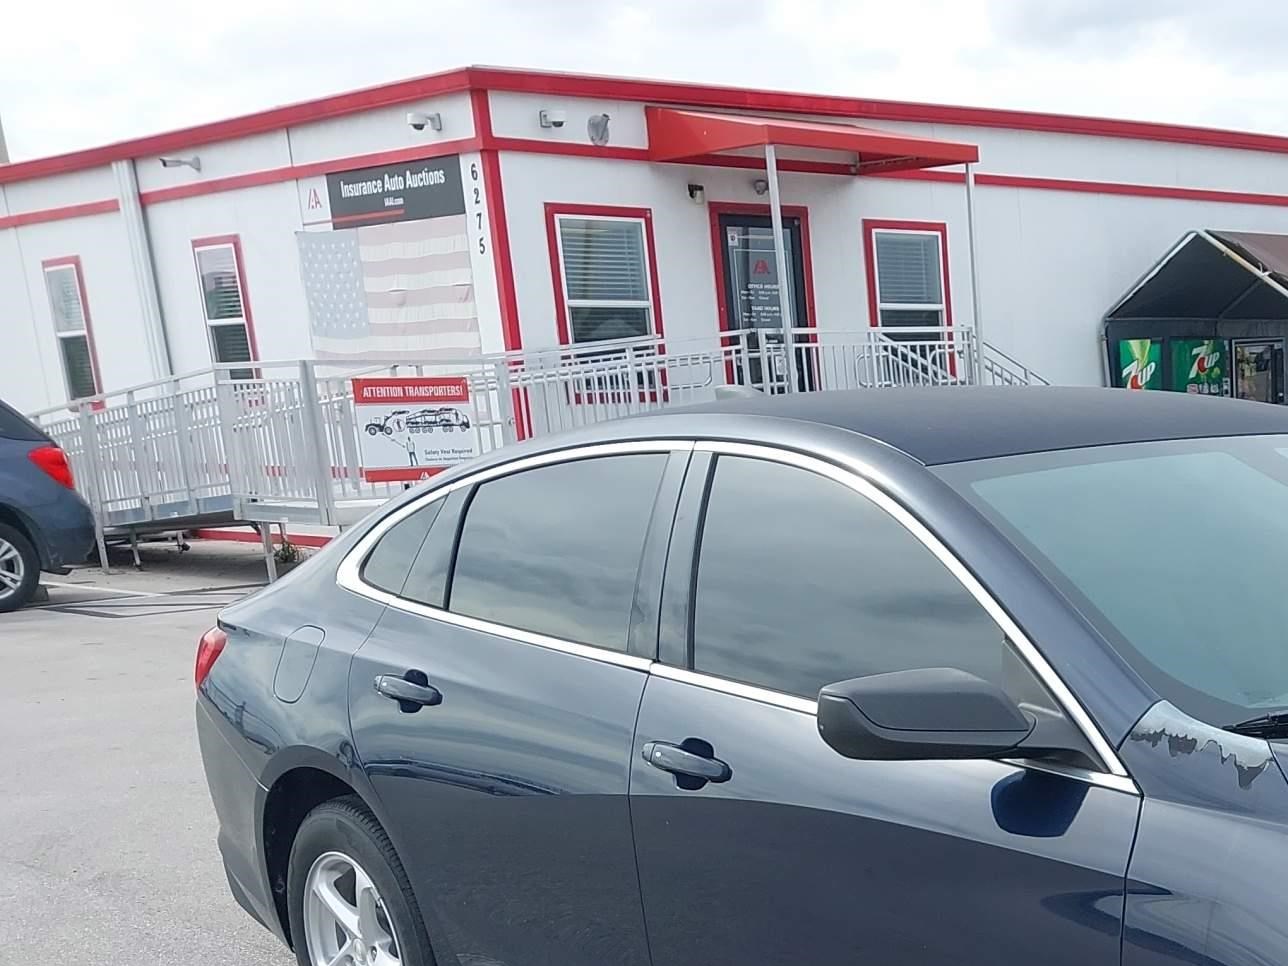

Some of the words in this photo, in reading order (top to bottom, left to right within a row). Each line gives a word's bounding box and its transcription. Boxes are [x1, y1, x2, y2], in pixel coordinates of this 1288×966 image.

[340, 180, 383, 198] Insurance
[383, 173, 405, 192] Auto
[405, 167, 446, 190] Auctions
[362, 386, 404, 398] ATTENTION
[405, 385, 463, 398] TRANSPORTERS!
